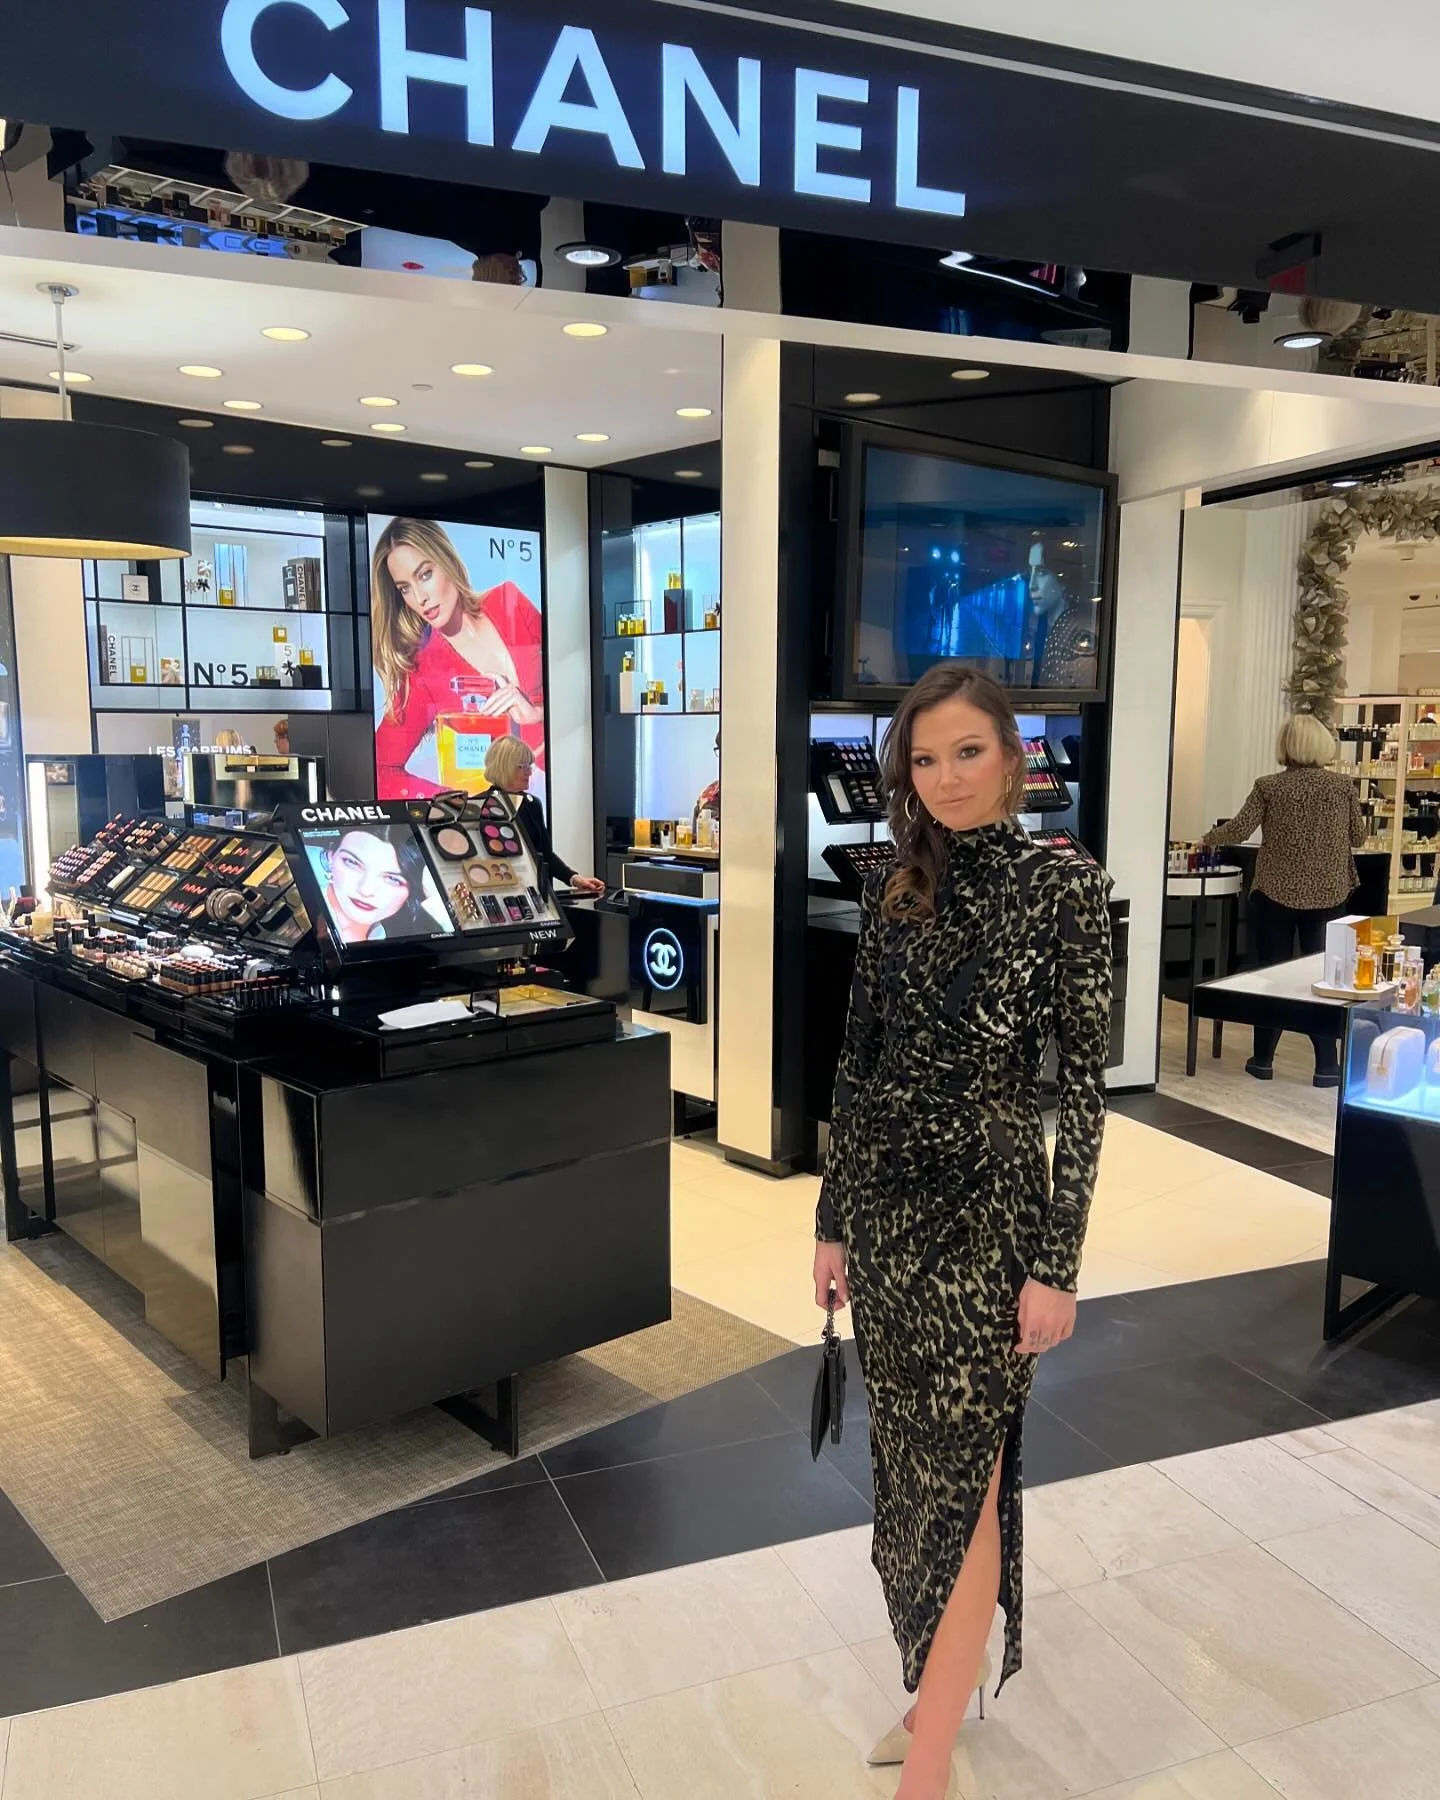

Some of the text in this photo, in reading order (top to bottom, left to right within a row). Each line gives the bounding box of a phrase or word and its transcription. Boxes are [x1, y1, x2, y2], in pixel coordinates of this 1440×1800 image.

[219, 0, 967, 217] CHANEL
[296, 566, 306, 603] CHANEL
[107, 635, 118, 676] CHANEL
[301, 806, 391, 822] CHANEL
[529, 929, 557, 941] NEW
